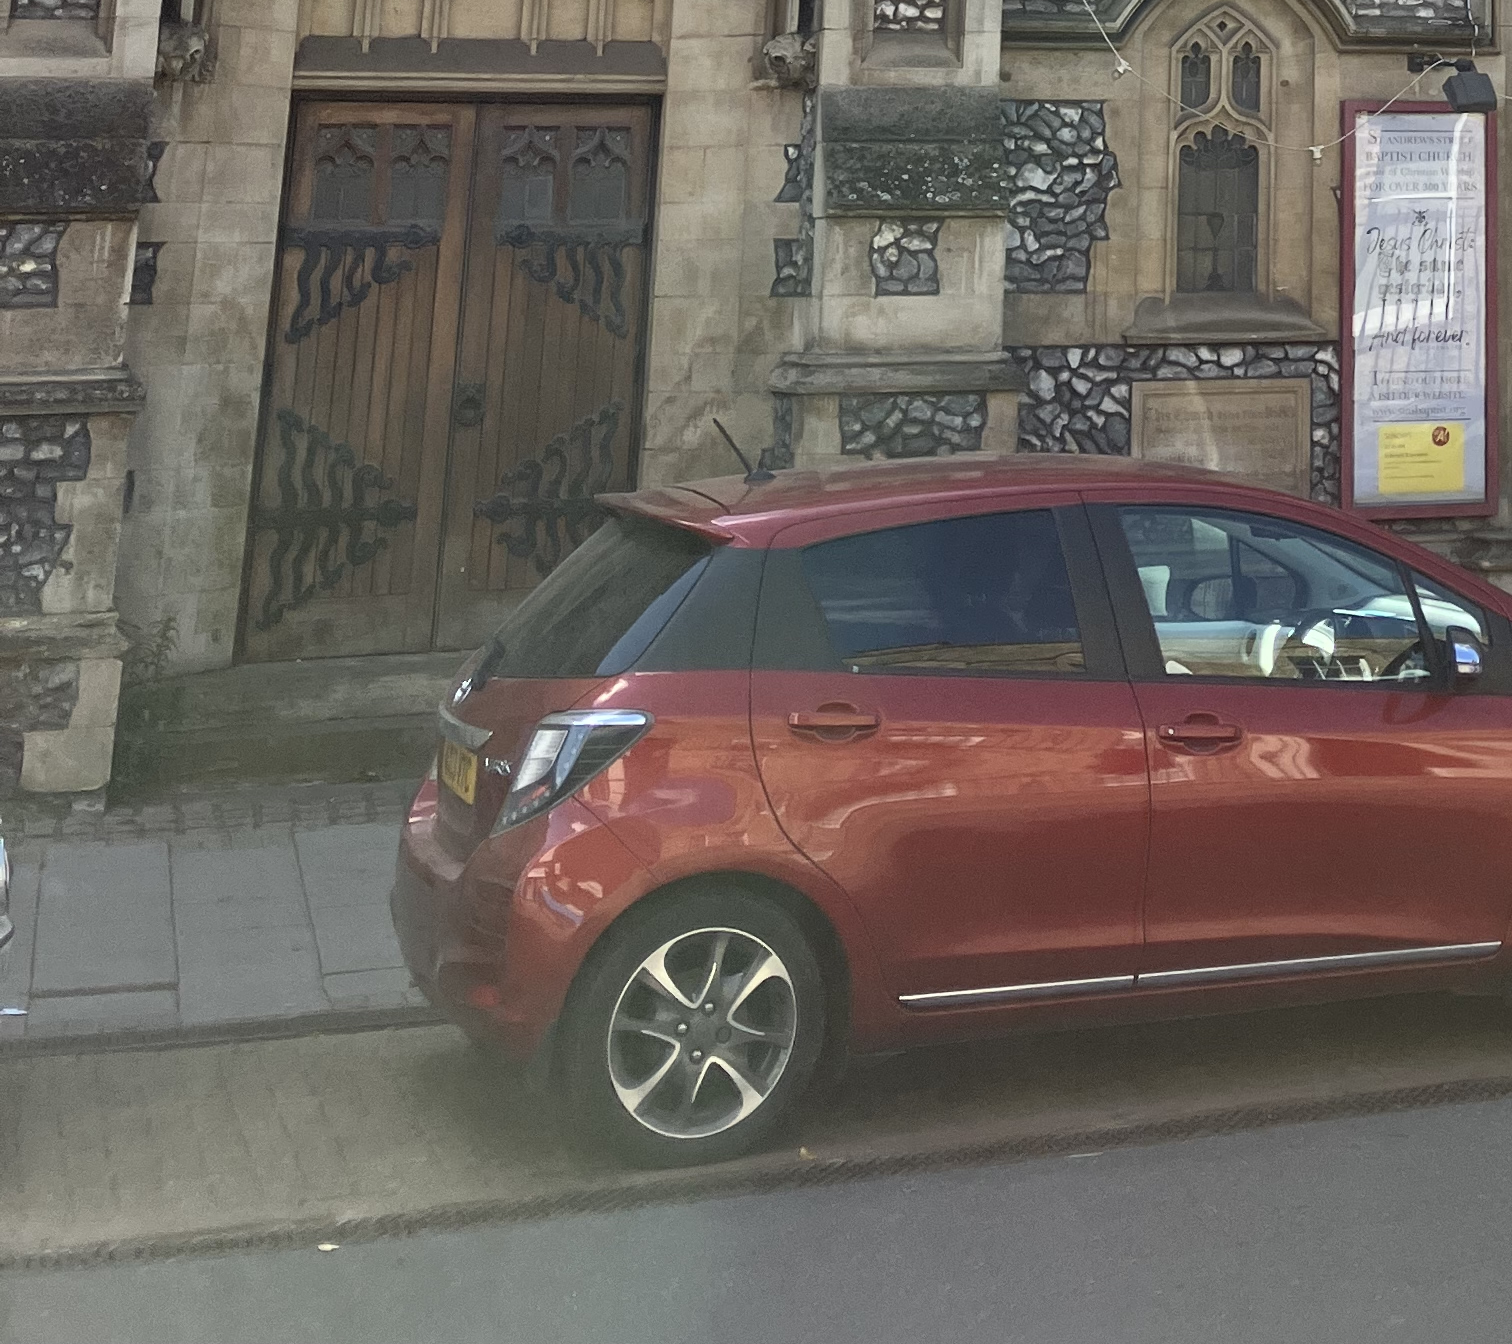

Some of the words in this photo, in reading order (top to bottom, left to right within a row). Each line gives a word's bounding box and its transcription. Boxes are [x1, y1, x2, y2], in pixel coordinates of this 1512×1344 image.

[1365, 151, 1413, 161] BAPTIST
[1363, 181, 1386, 192] FOR
[1389, 181, 1420, 192] OVER
[1422, 182, 1439, 192] 300
[1366, 226, 1412, 254] Jesus
